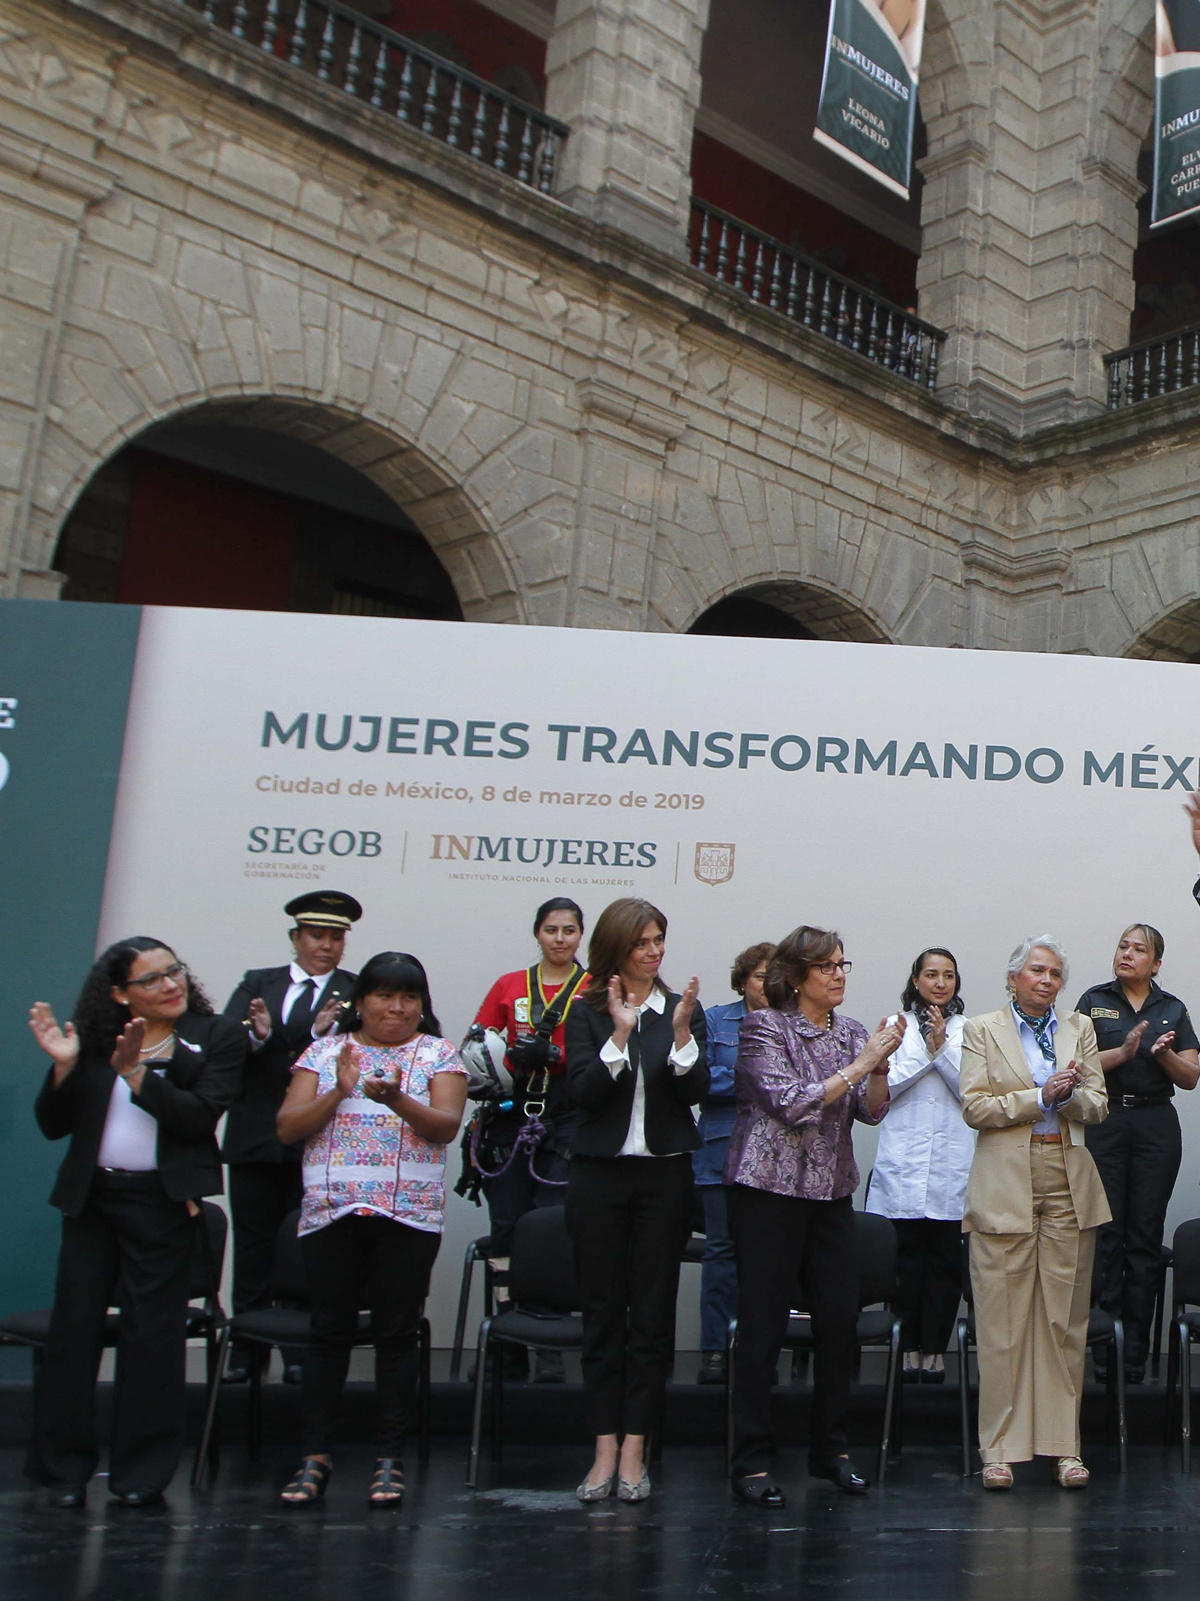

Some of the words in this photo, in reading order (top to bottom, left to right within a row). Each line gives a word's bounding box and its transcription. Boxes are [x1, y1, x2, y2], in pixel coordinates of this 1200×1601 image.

[832, 34, 909, 101] INMUJERES
[841, 108, 890, 149] VICARIO
[849, 97, 885, 132] LEONA
[261, 710, 531, 759] MUJERES
[548, 724, 1064, 784] TRANSFORMANDO
[255, 774, 341, 795] Ciudad
[347, 779, 378, 796] de
[385, 780, 474, 804] México,
[480, 785, 496, 801] 8
[502, 786, 532, 803] de
[539, 790, 612, 806] marzo
[619, 791, 648, 808] de
[654, 793, 705, 810] 2019
[247, 826, 382, 857] SEGOB
[429, 834, 658, 868] INMUJERES
[449, 873, 499, 881] INSTITUTO
[502, 874, 550, 883] NACIONAL
[554, 876, 567, 884] DE
[570, 877, 588, 885] LAS
[591, 878, 635, 887] MUJERES
